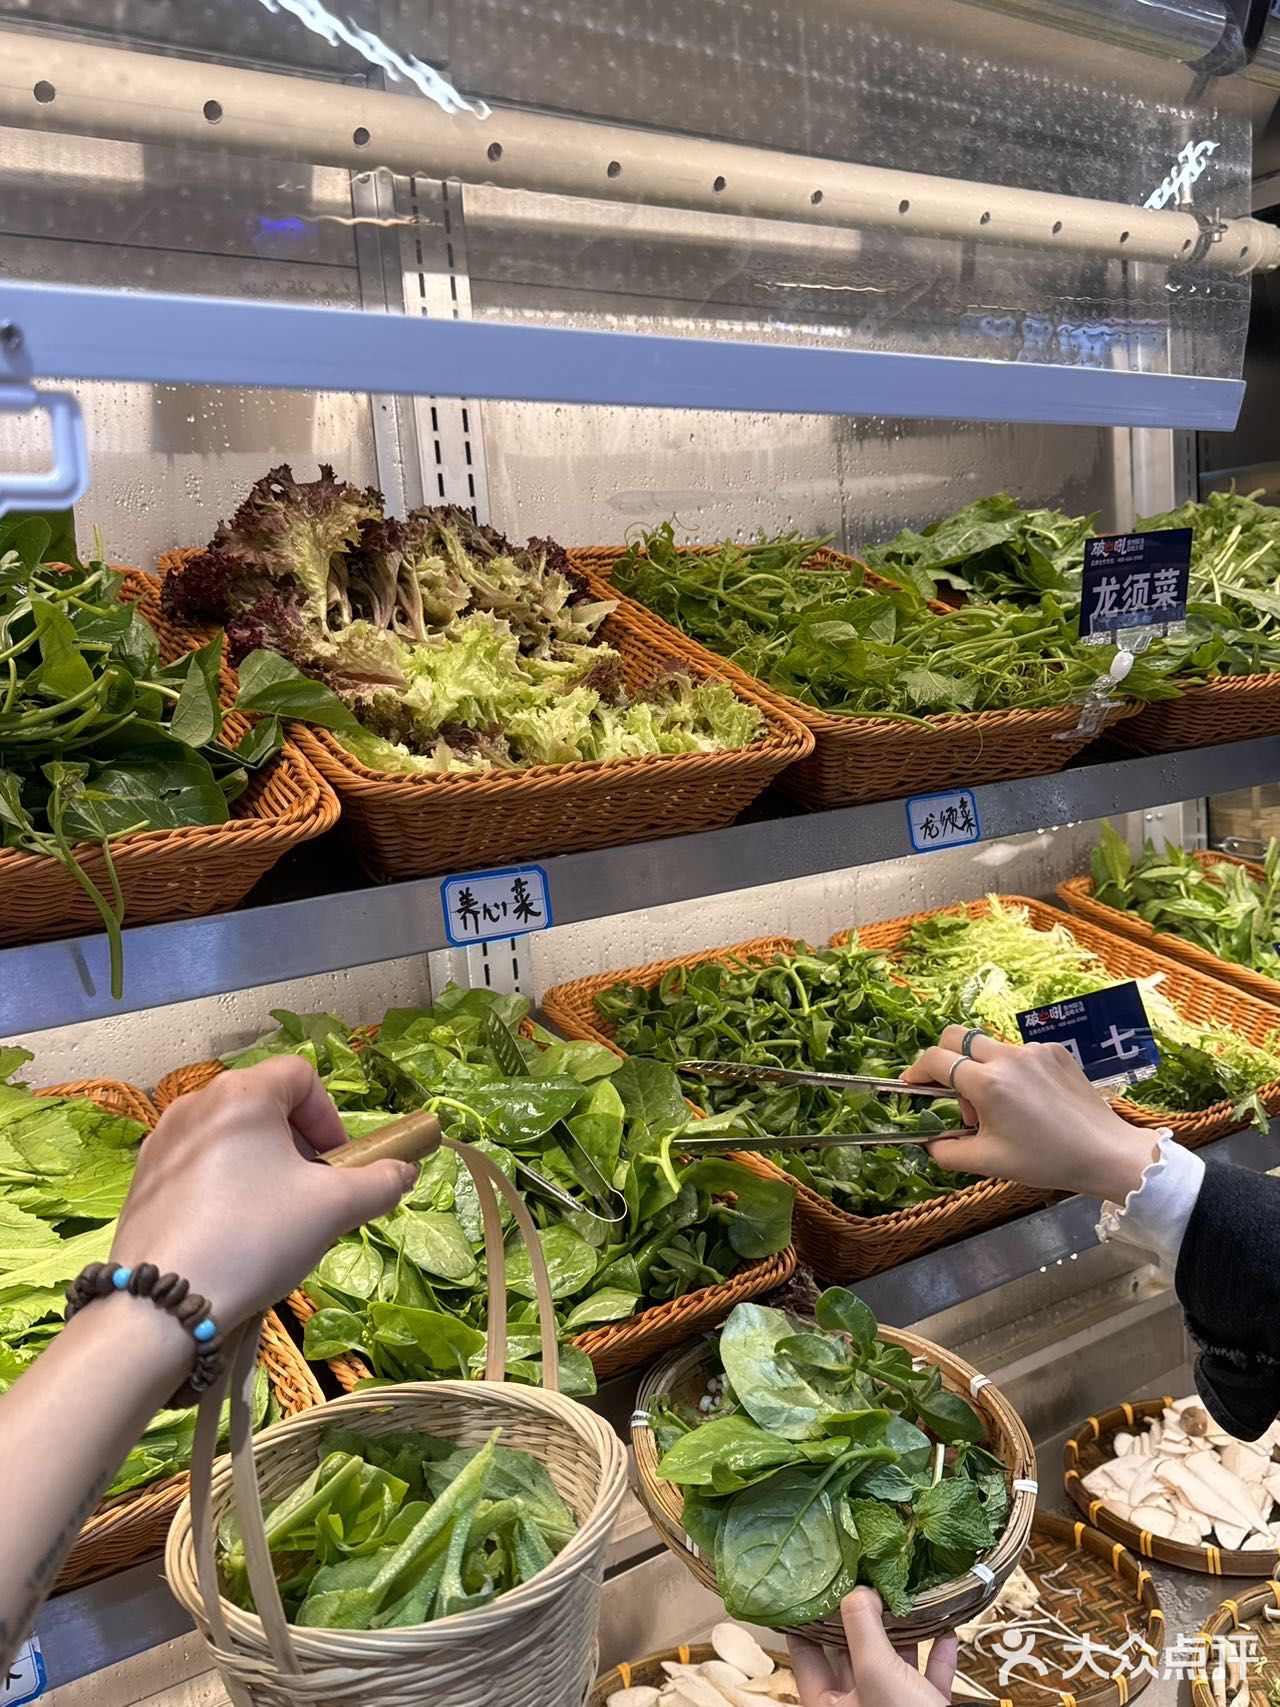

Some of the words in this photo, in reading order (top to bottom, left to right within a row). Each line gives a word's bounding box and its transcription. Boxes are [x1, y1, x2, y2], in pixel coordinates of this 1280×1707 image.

[1090, 567, 1180, 619] 龙须菜
[920, 797, 976, 840] 龙须菜
[456, 877, 542, 935] 养心菜
